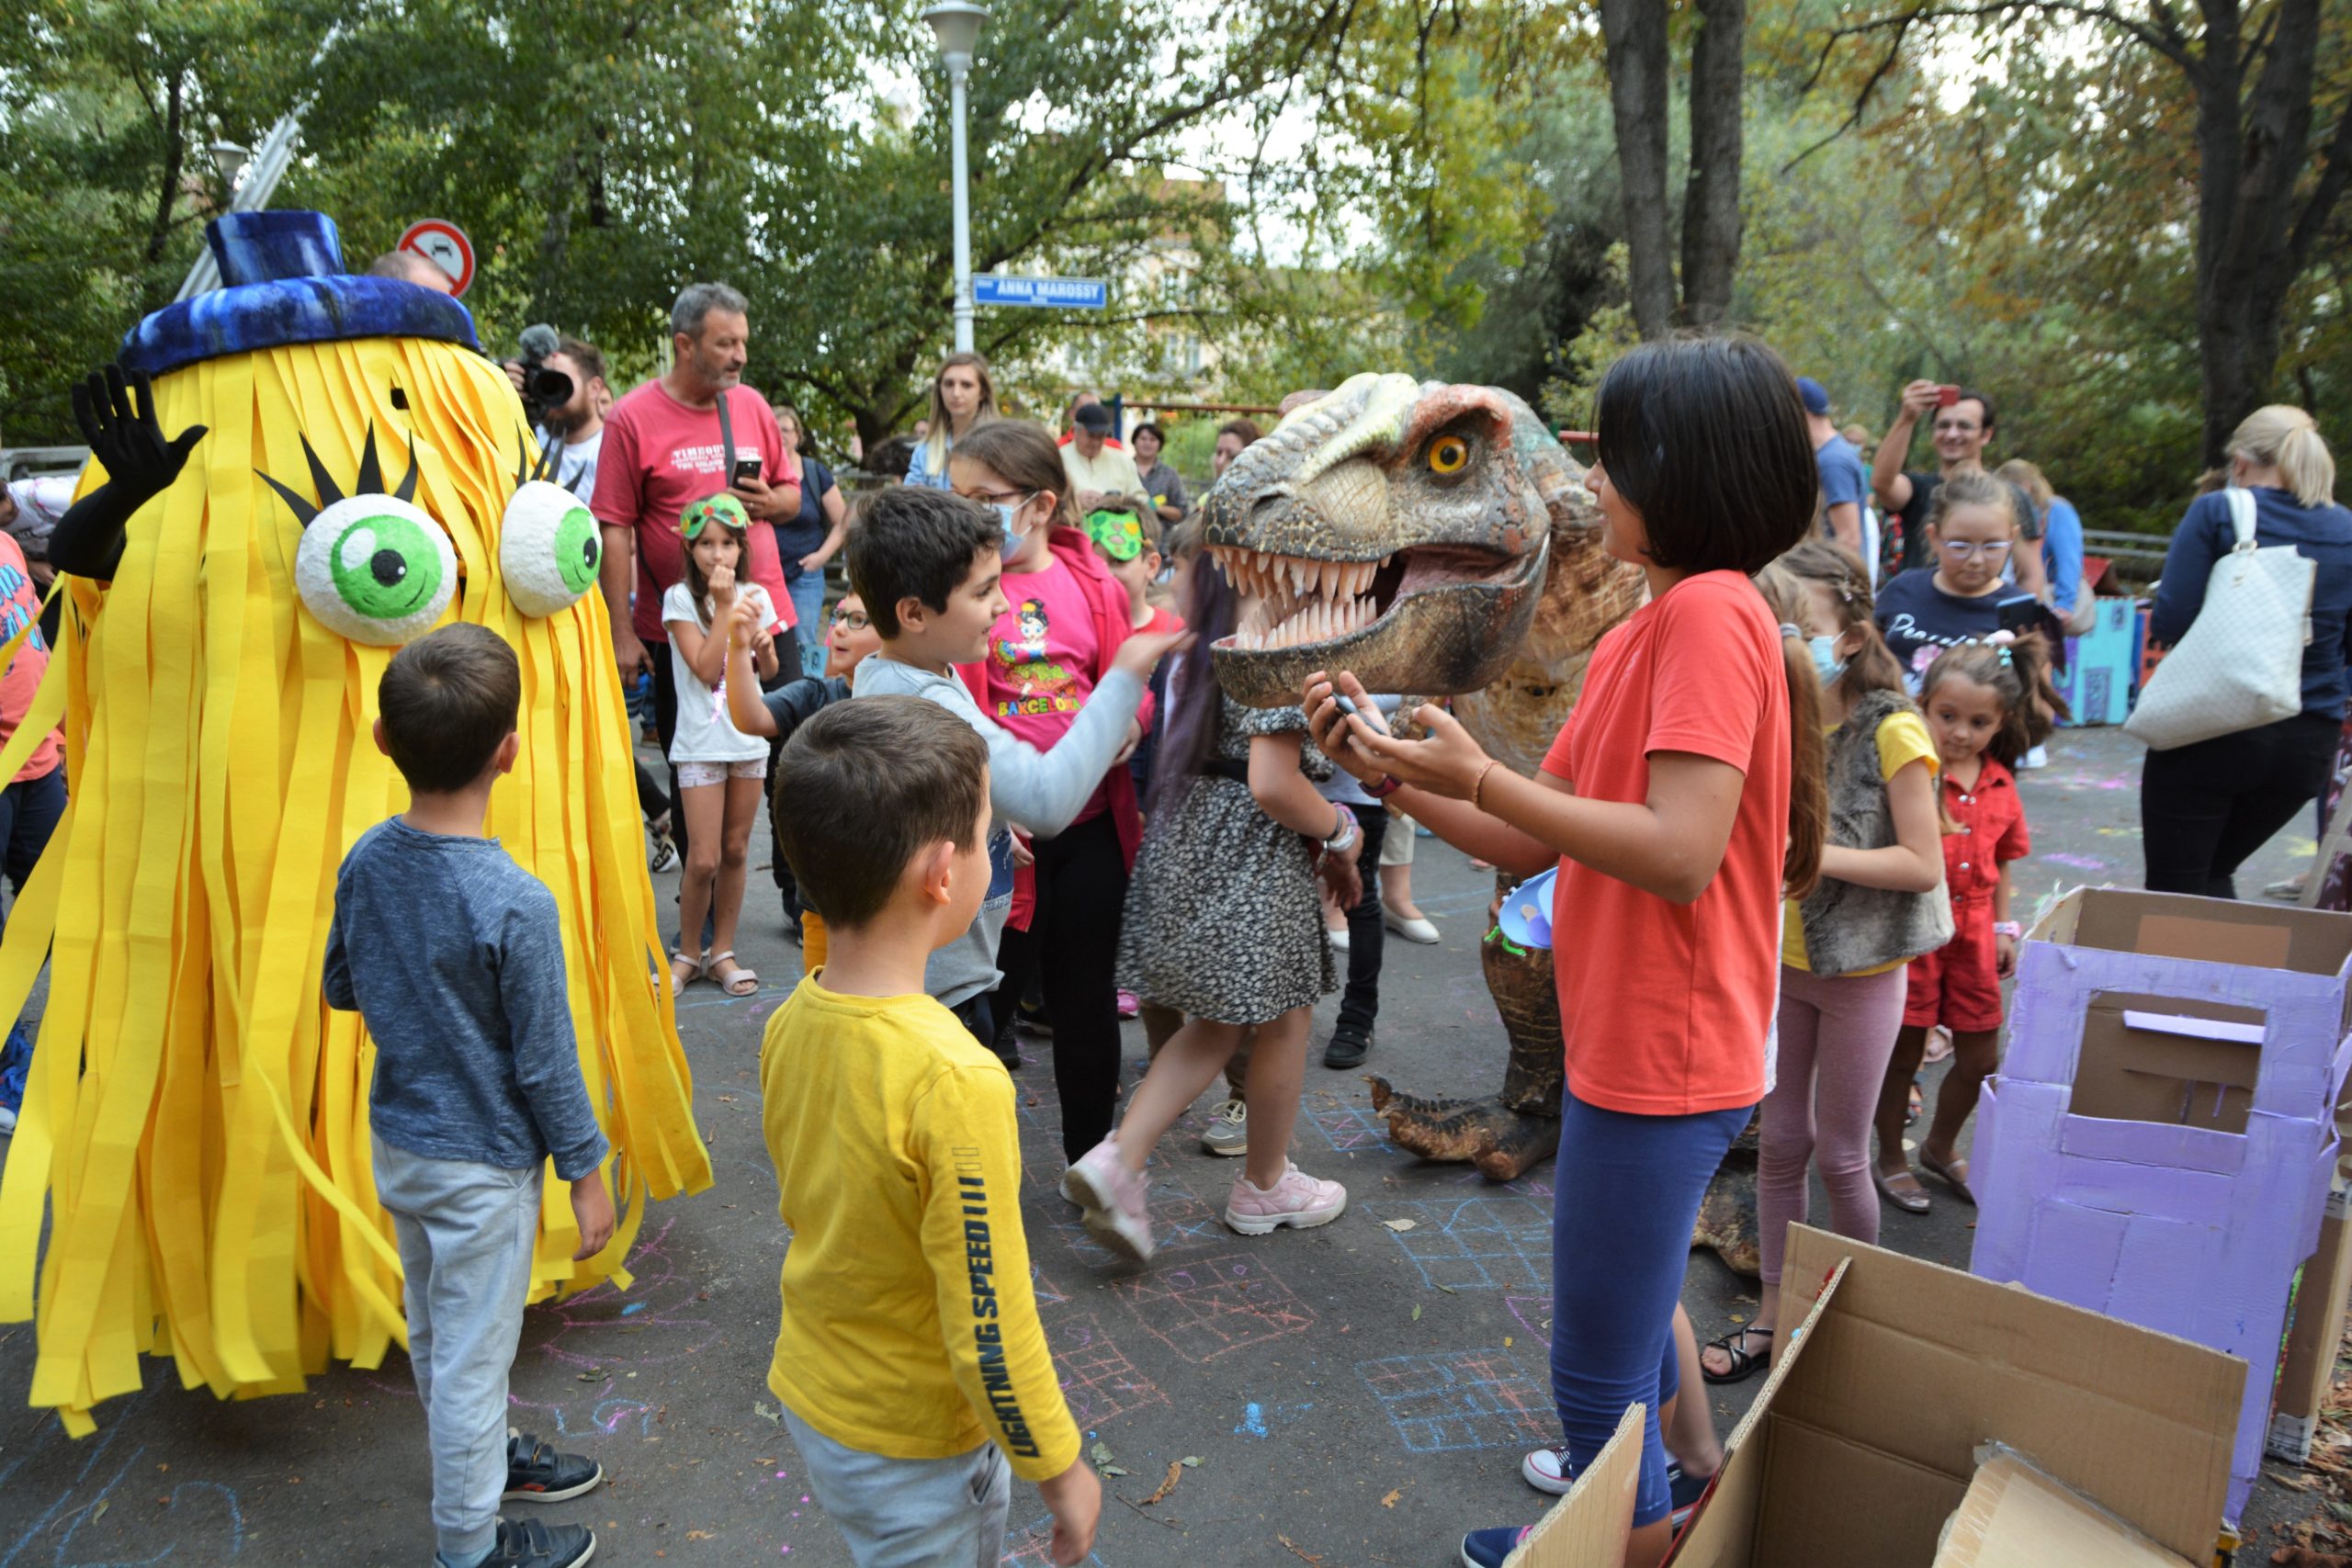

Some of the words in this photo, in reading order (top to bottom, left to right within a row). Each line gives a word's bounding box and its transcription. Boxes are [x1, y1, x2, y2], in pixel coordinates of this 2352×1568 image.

[997, 278, 1035, 296] ANNA
[1035, 281, 1100, 299] MAROSSY
[998, 696, 1081, 717] BARCELONA
[974, 1323, 1041, 1459] LIGHTNING
